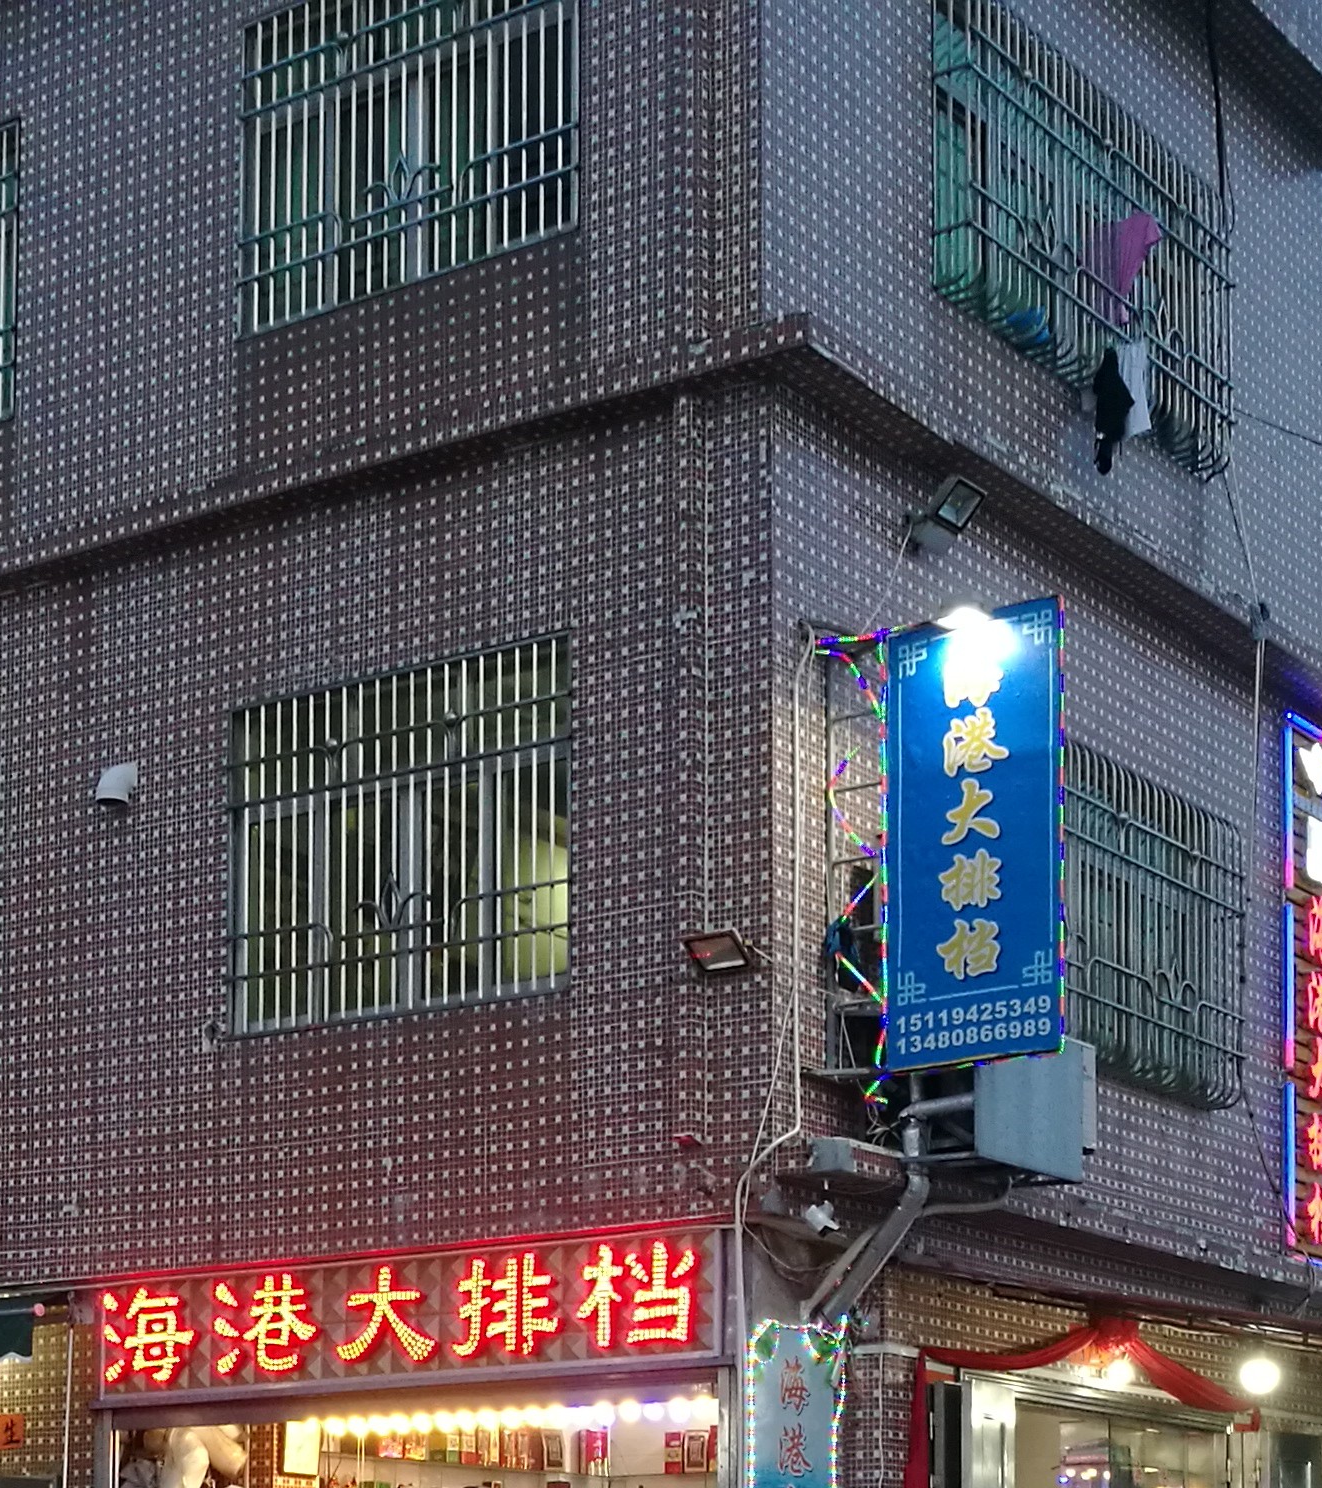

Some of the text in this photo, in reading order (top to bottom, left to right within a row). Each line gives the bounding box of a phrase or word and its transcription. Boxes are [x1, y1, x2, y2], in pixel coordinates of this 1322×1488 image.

[937, 638, 1008, 978] 港大排档
[896, 996, 1051, 1034] 15119425349
[896, 1018, 1052, 1055] 13480866989
[101, 1239, 697, 1385] 海港大排档
